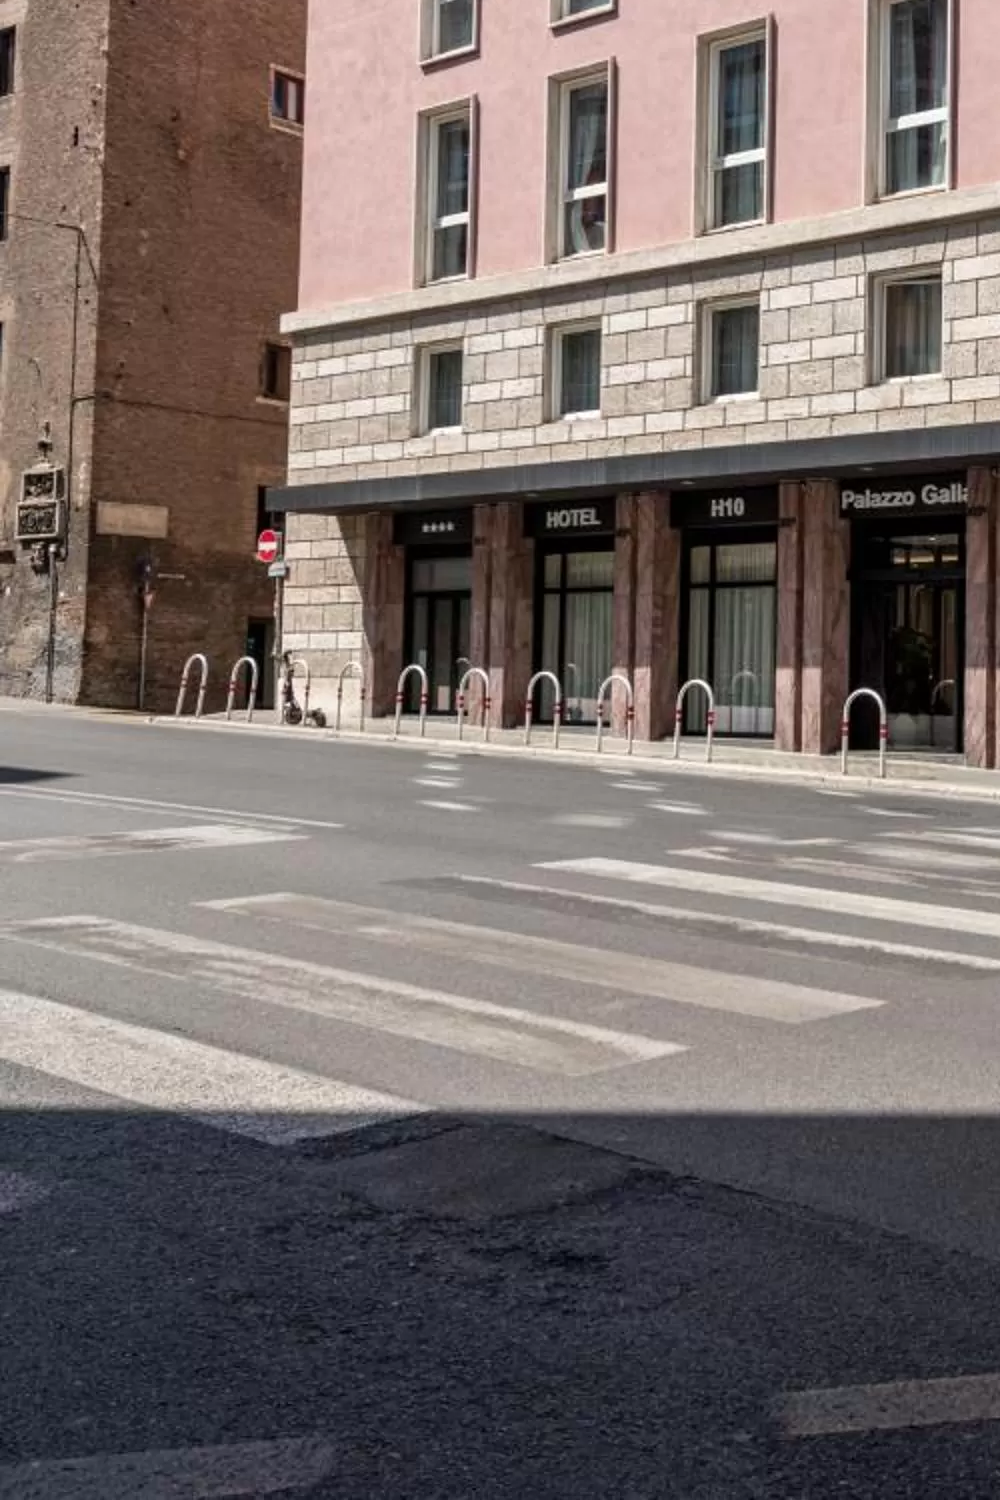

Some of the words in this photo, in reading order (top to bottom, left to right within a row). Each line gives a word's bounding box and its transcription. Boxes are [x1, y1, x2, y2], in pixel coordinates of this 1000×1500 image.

[711, 497, 745, 517] H10
[841, 488, 916, 510] Palazzo
[546, 507, 602, 529] HOTEL
